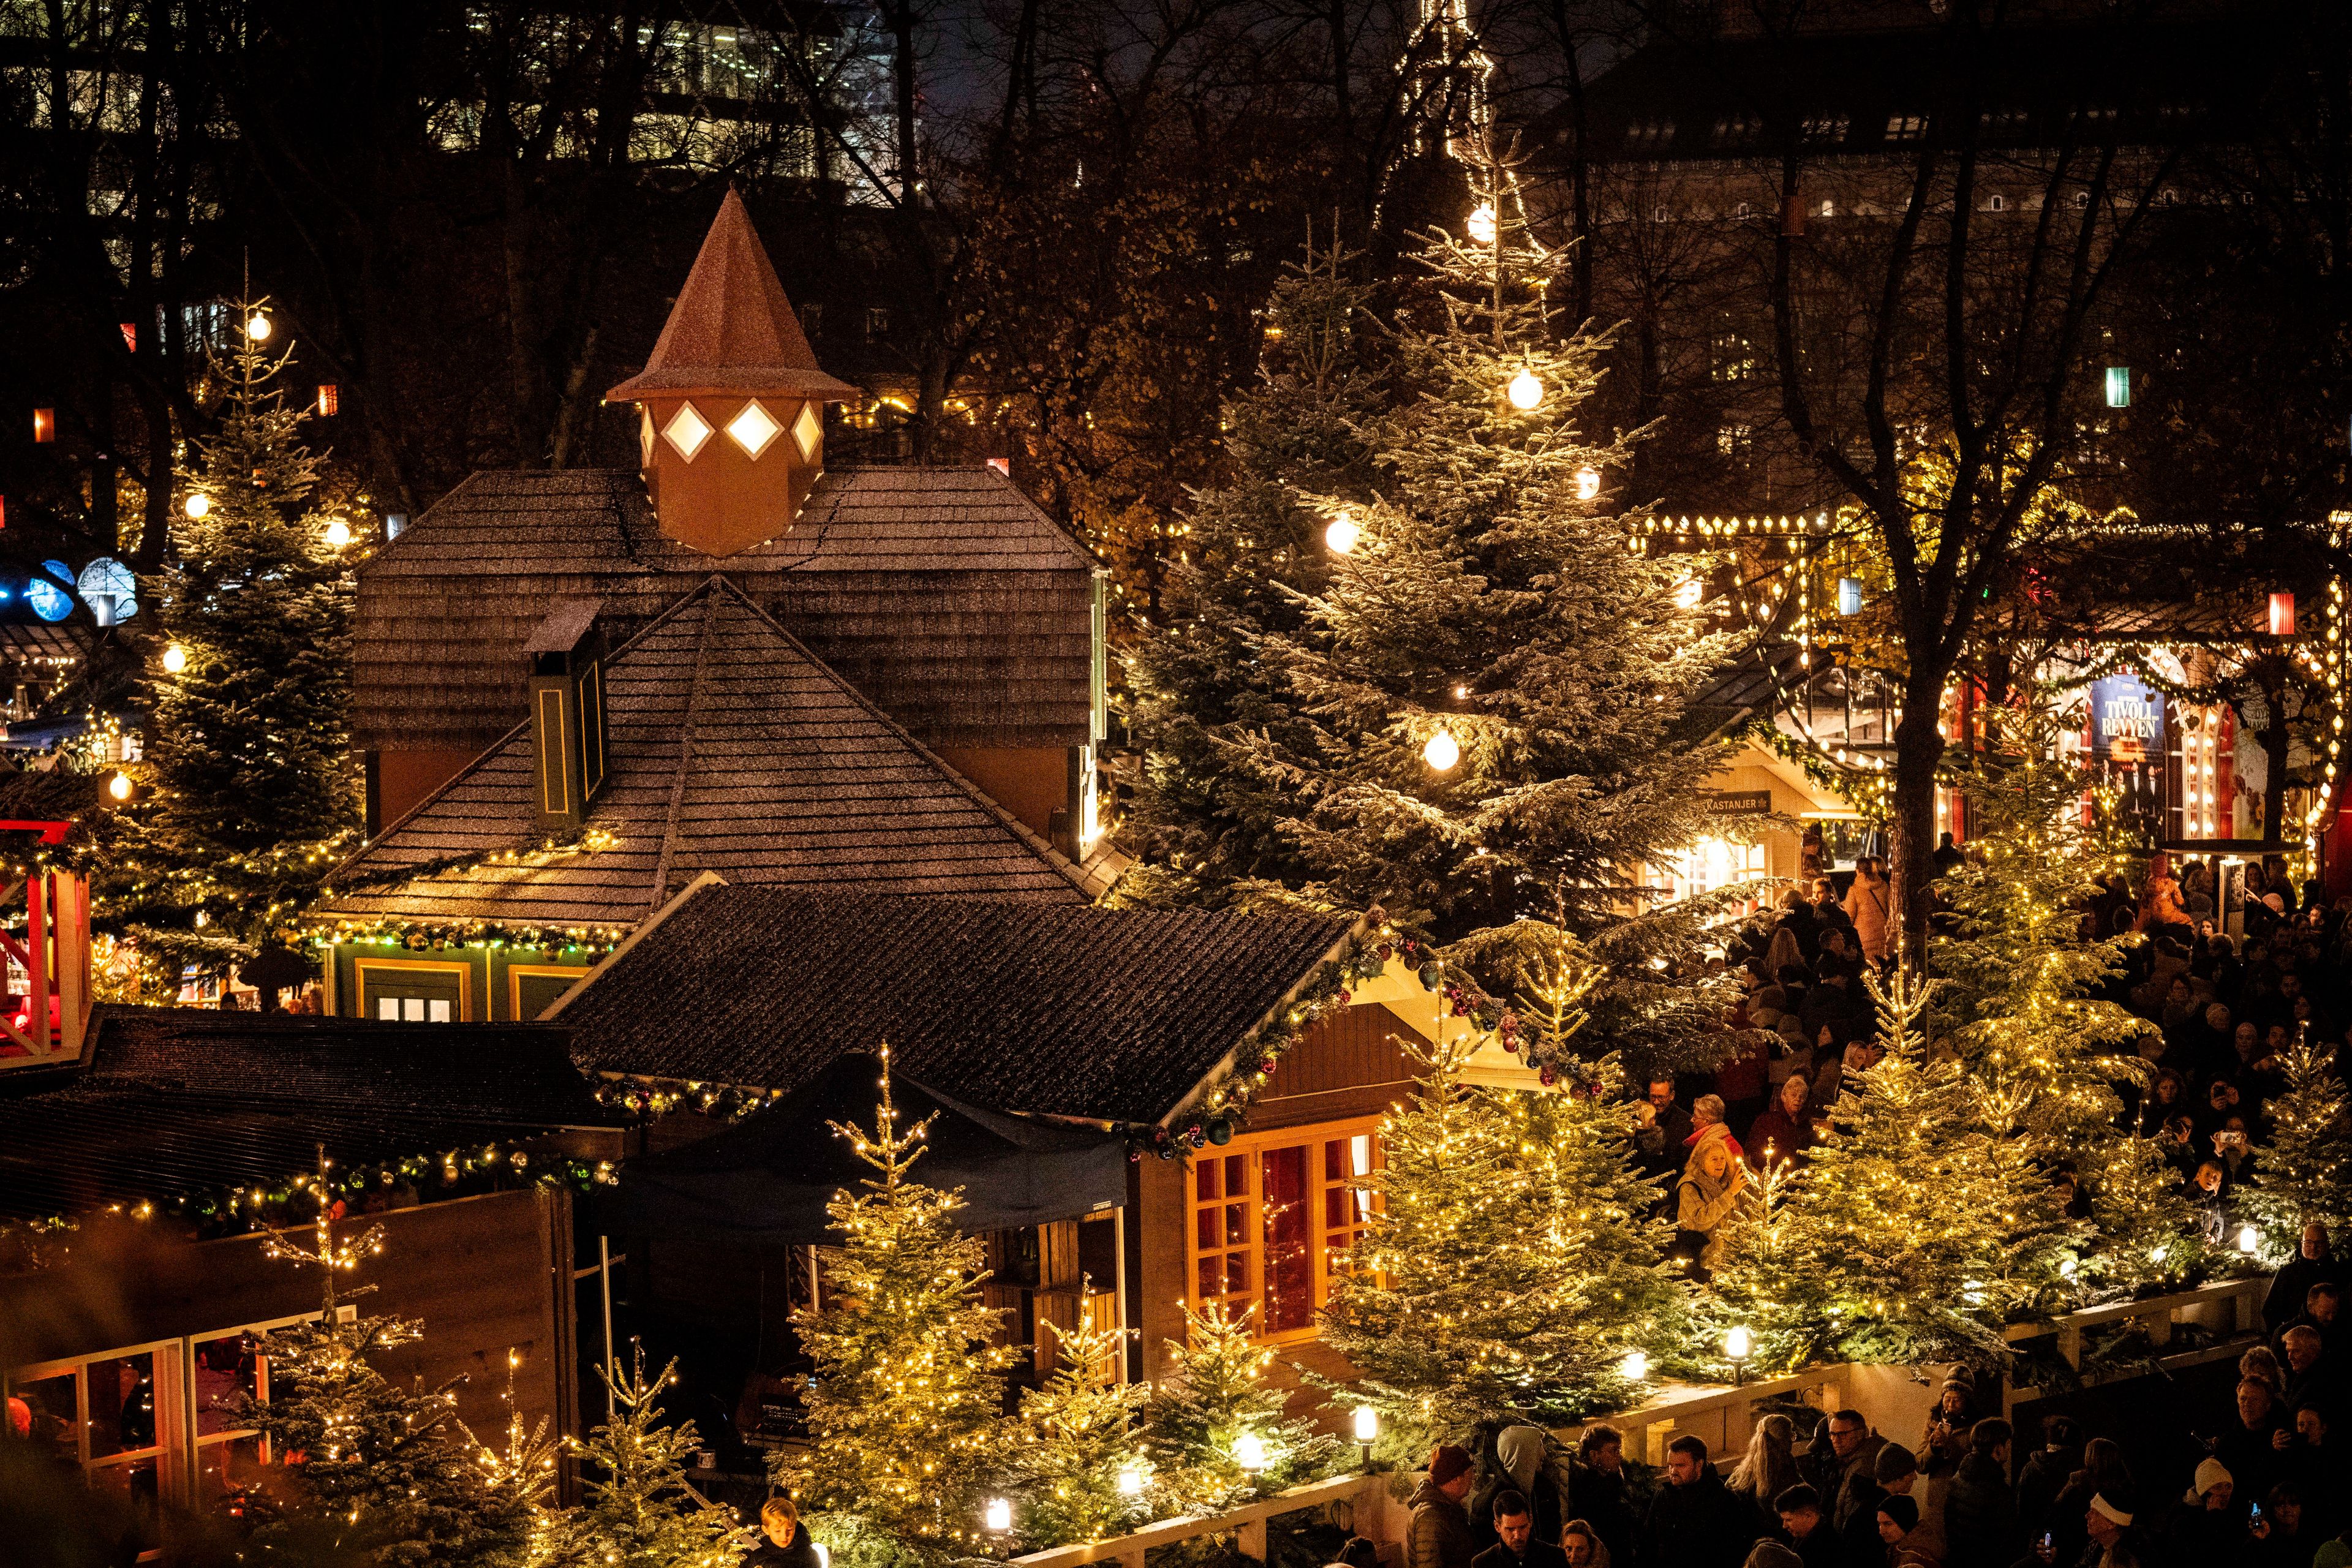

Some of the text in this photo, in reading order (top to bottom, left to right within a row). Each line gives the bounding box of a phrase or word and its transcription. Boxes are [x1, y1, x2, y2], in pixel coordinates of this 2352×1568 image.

[2105, 701, 2151, 720] TIVOLI
[2102, 718, 2155, 738] REVYEN
[1706, 799, 1757, 810] KASTANJER
